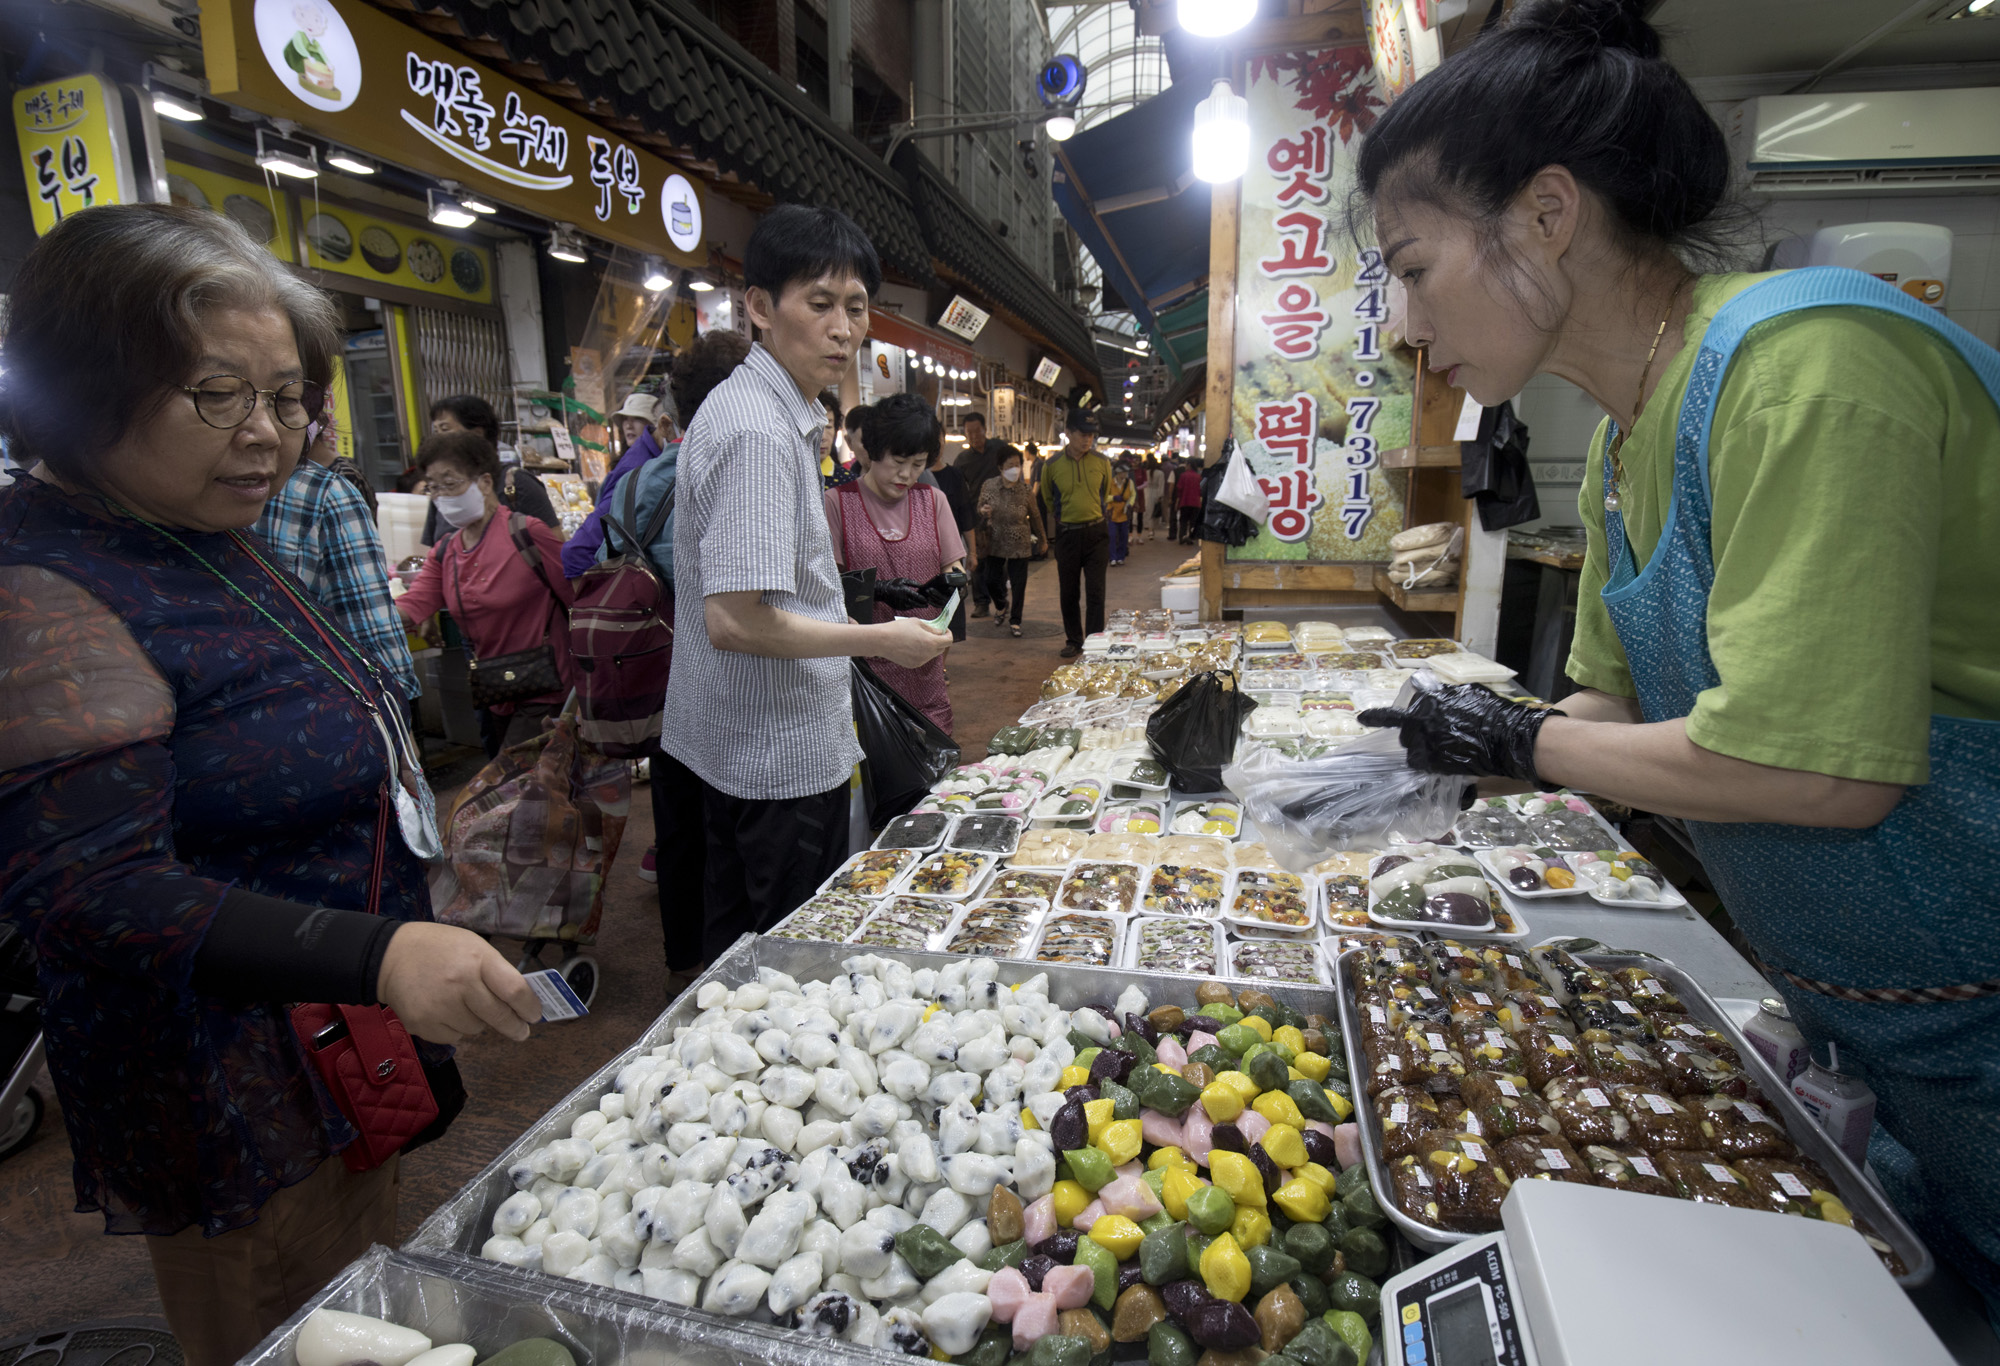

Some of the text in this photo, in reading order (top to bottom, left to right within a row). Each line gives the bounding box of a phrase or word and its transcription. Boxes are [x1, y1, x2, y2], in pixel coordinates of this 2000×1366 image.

[24, 87, 84, 126] 맷돌 수제
[407, 52, 645, 221] 맷돌 수제 두부
[31, 136, 98, 224] 두부
[1254, 124, 1333, 540] 옛고을 떡방
[1494, 1284, 1511, 1321] PC-500
